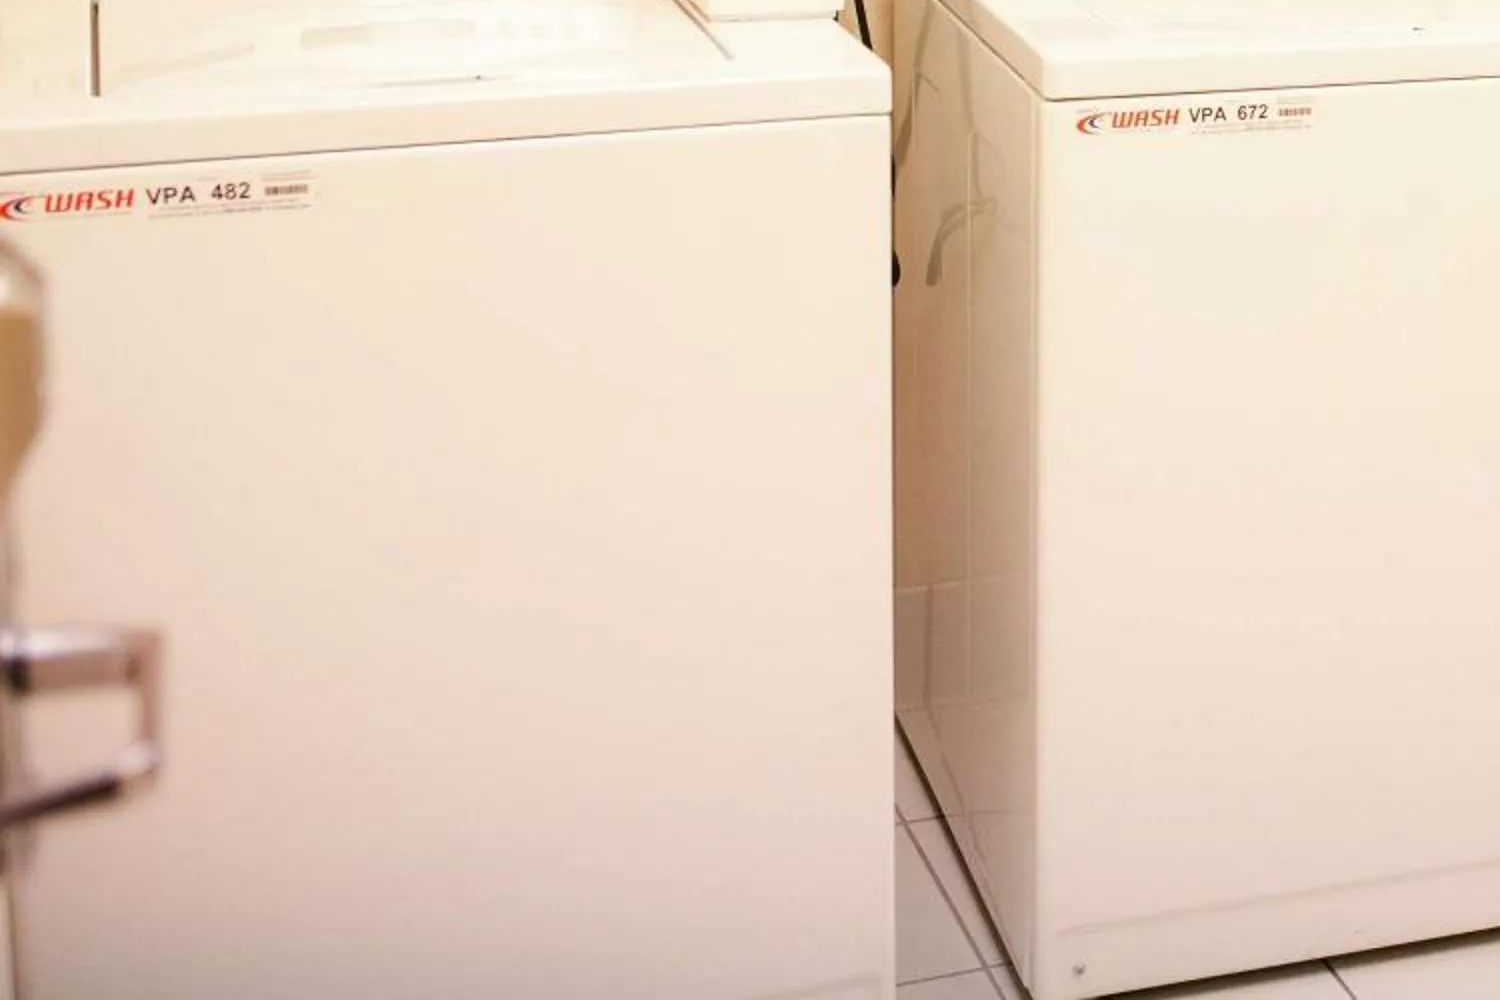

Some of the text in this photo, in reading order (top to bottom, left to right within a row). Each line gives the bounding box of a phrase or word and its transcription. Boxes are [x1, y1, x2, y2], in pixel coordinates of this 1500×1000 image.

[1110, 108, 1181, 129] WASH
[1188, 107, 1228, 123] VPA
[1236, 103, 1270, 121] 672
[43, 187, 136, 214] WASH
[145, 186, 197, 205] VPA
[210, 180, 252, 200] 482
